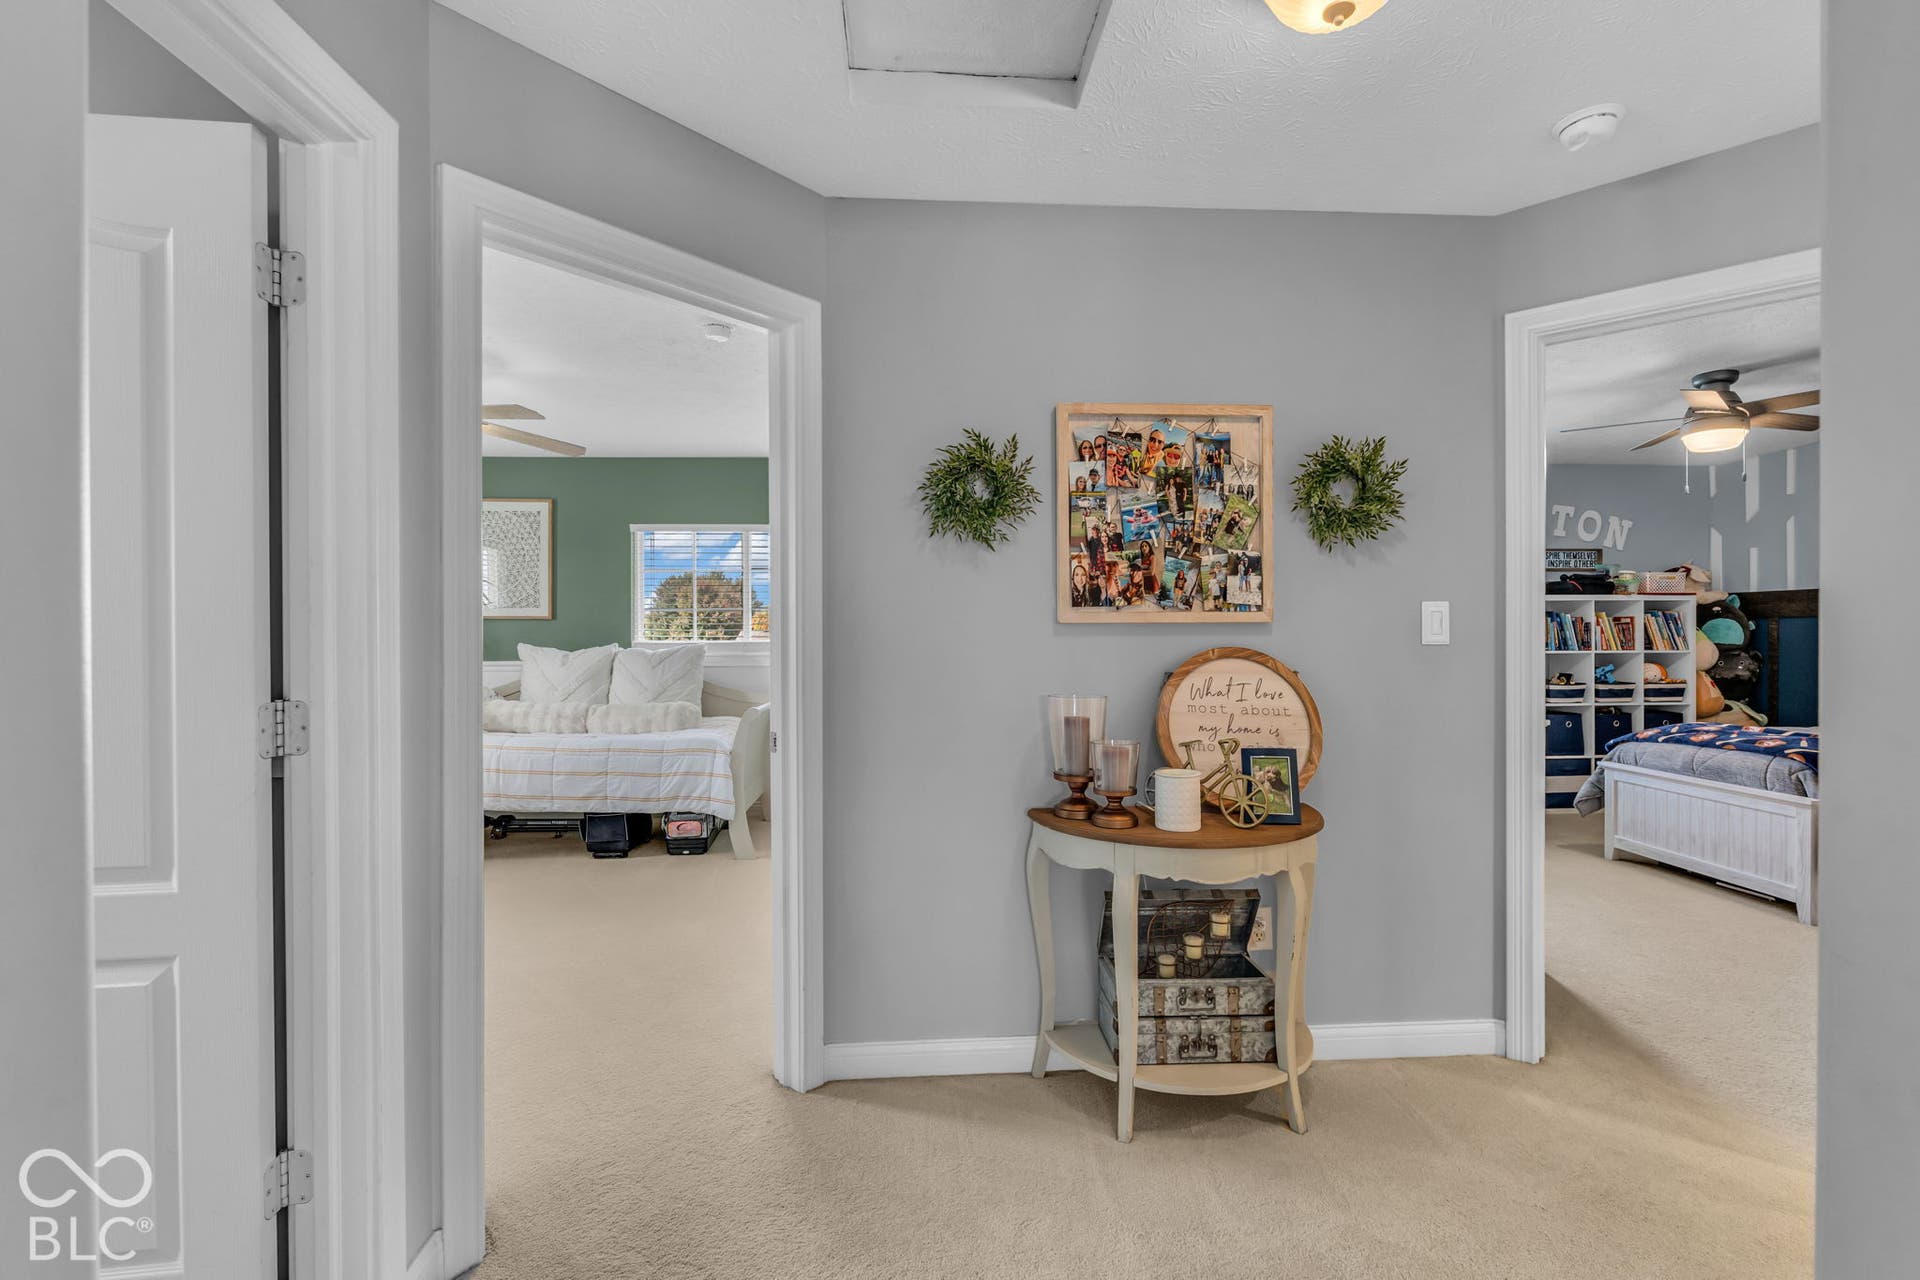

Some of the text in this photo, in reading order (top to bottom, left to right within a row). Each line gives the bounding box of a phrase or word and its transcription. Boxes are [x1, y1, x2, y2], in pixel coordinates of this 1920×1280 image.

[1552, 504, 1633, 551] TON
[1547, 560, 1571, 568] INSPIRE
[1563, 551, 1597, 560] THEMSELVES
[1190, 676, 1284, 702] What I love
[1187, 704, 1292, 717] most about
[1198, 713, 1280, 742] my home is
